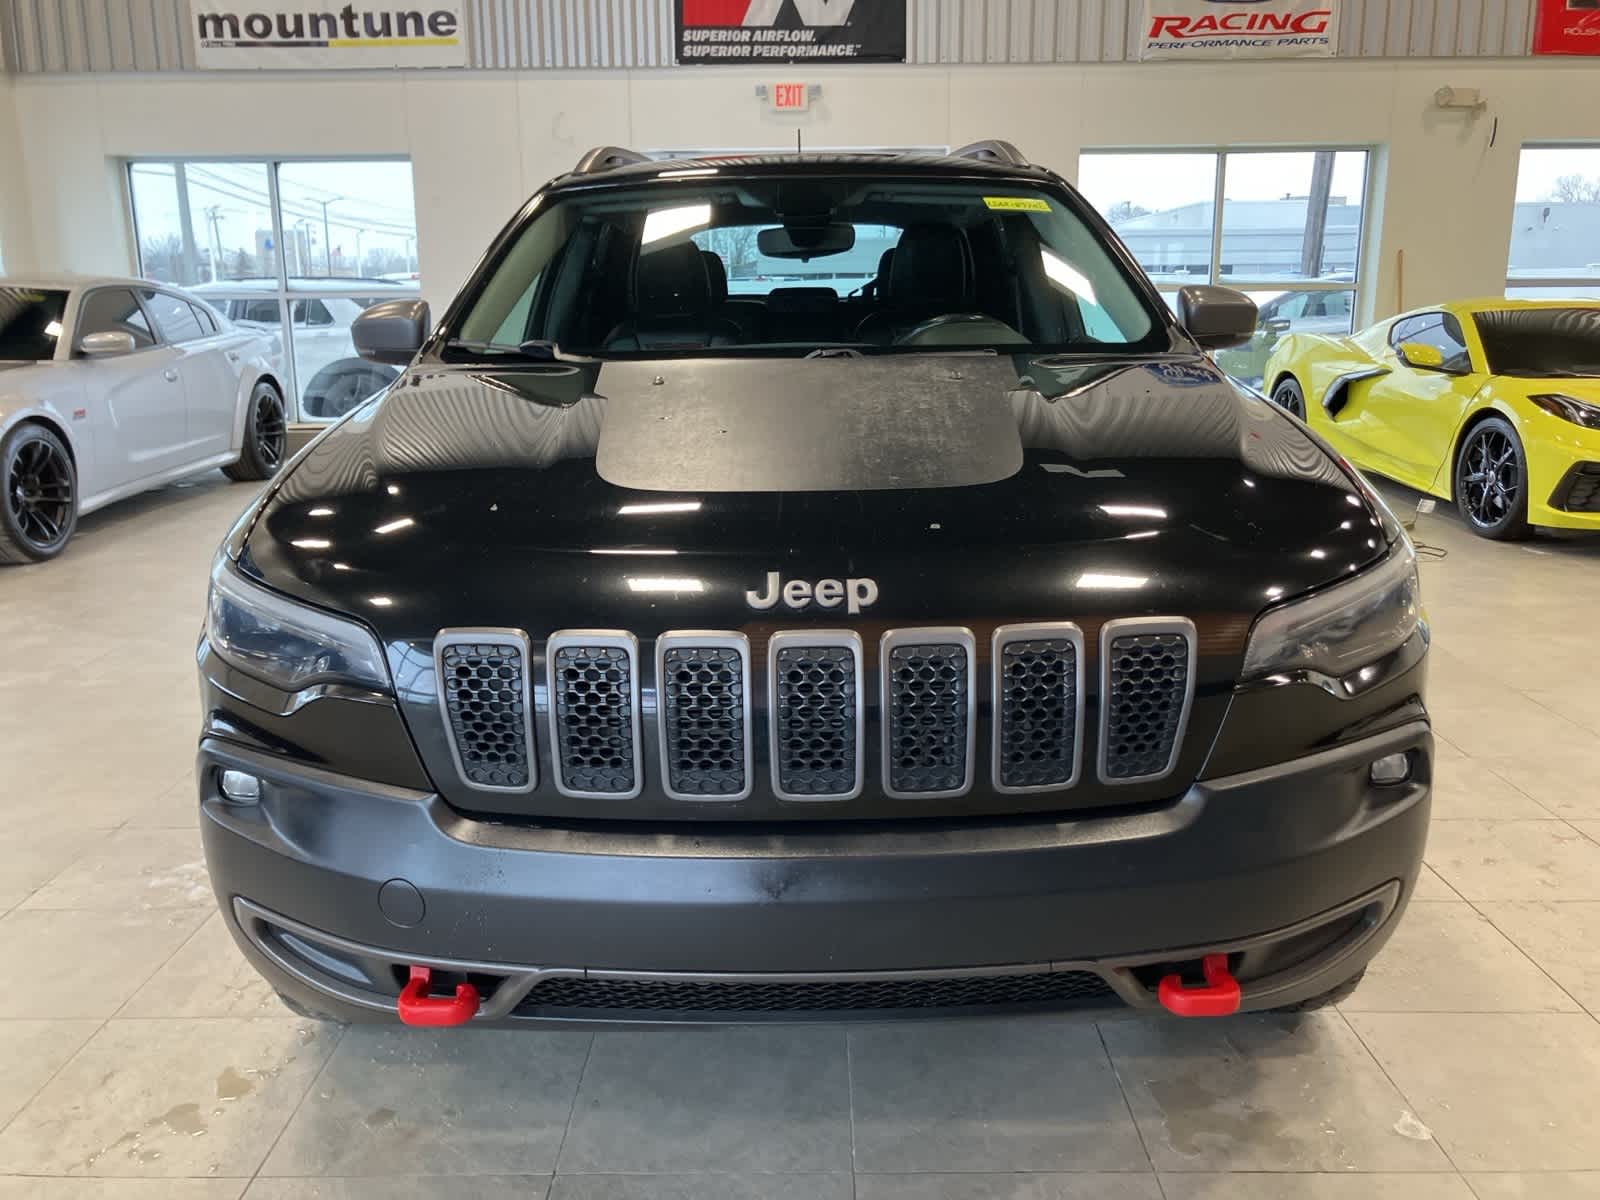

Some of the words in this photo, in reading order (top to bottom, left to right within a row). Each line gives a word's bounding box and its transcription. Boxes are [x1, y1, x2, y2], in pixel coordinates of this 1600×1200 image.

[197, 4, 457, 38] mountune
[1148, 11, 1332, 39] RACING
[683, 30, 750, 42] SUPERIOR
[752, 30, 816, 42] AIRFLOW.
[1147, 39, 1273, 49] PERFORMANCE
[1277, 37, 1329, 46] PARTS
[683, 45, 750, 57] SUPERIOR
[775, 84, 804, 107] EXIT
[746, 571, 879, 614] Jeep
